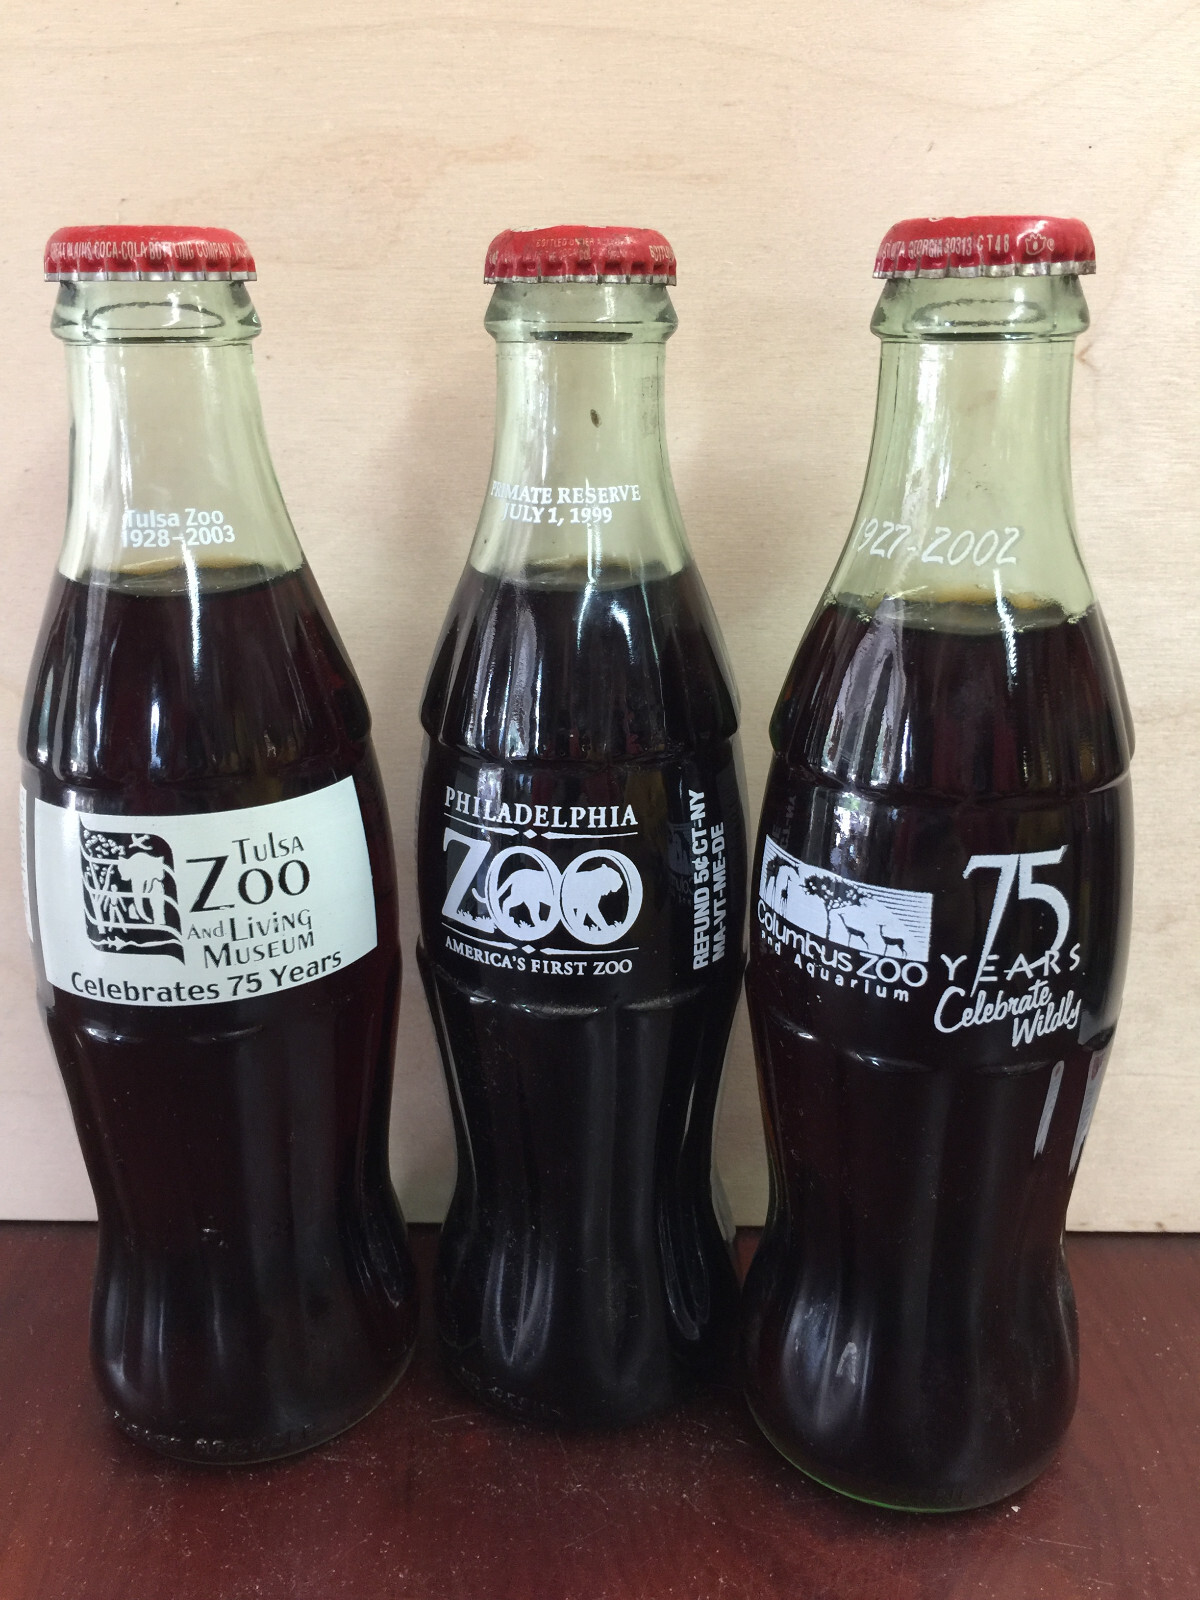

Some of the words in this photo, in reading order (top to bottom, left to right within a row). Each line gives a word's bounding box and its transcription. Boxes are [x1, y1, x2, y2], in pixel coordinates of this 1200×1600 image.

[94, 241, 147, 260] COCA-COLA
[944, 236, 972, 256] 30313
[490, 480, 553, 504] PRIMATE
[556, 484, 641, 504] RESERVE
[501, 502, 544, 523] JULY
[547, 507, 565, 527] 1,
[569, 507, 613, 524] 1999
[124, 509, 180, 528] Tulsa
[184, 508, 224, 526] Zoo
[444, 786, 638, 828] PHILADELPHIA
[442, 825, 643, 945] ZOO
[693, 886, 711, 970] REFUND
[757, 899, 853, 973] Columbus
[962, 844, 1070, 997] 75
[71, 971, 220, 1003] Celebrates
[227, 972, 264, 998] 75
[270, 949, 342, 989] Years
[445, 935, 526, 971] AMERICA'S
[531, 960, 587, 976] FIRST
[593, 958, 633, 976] ZOO
[761, 929, 782, 956] and
[794, 953, 910, 1002] Aquarium
[940, 943, 1081, 981] YEARS
[934, 979, 1053, 1034] Celebrate
[1012, 989, 1082, 1048] Wildly
